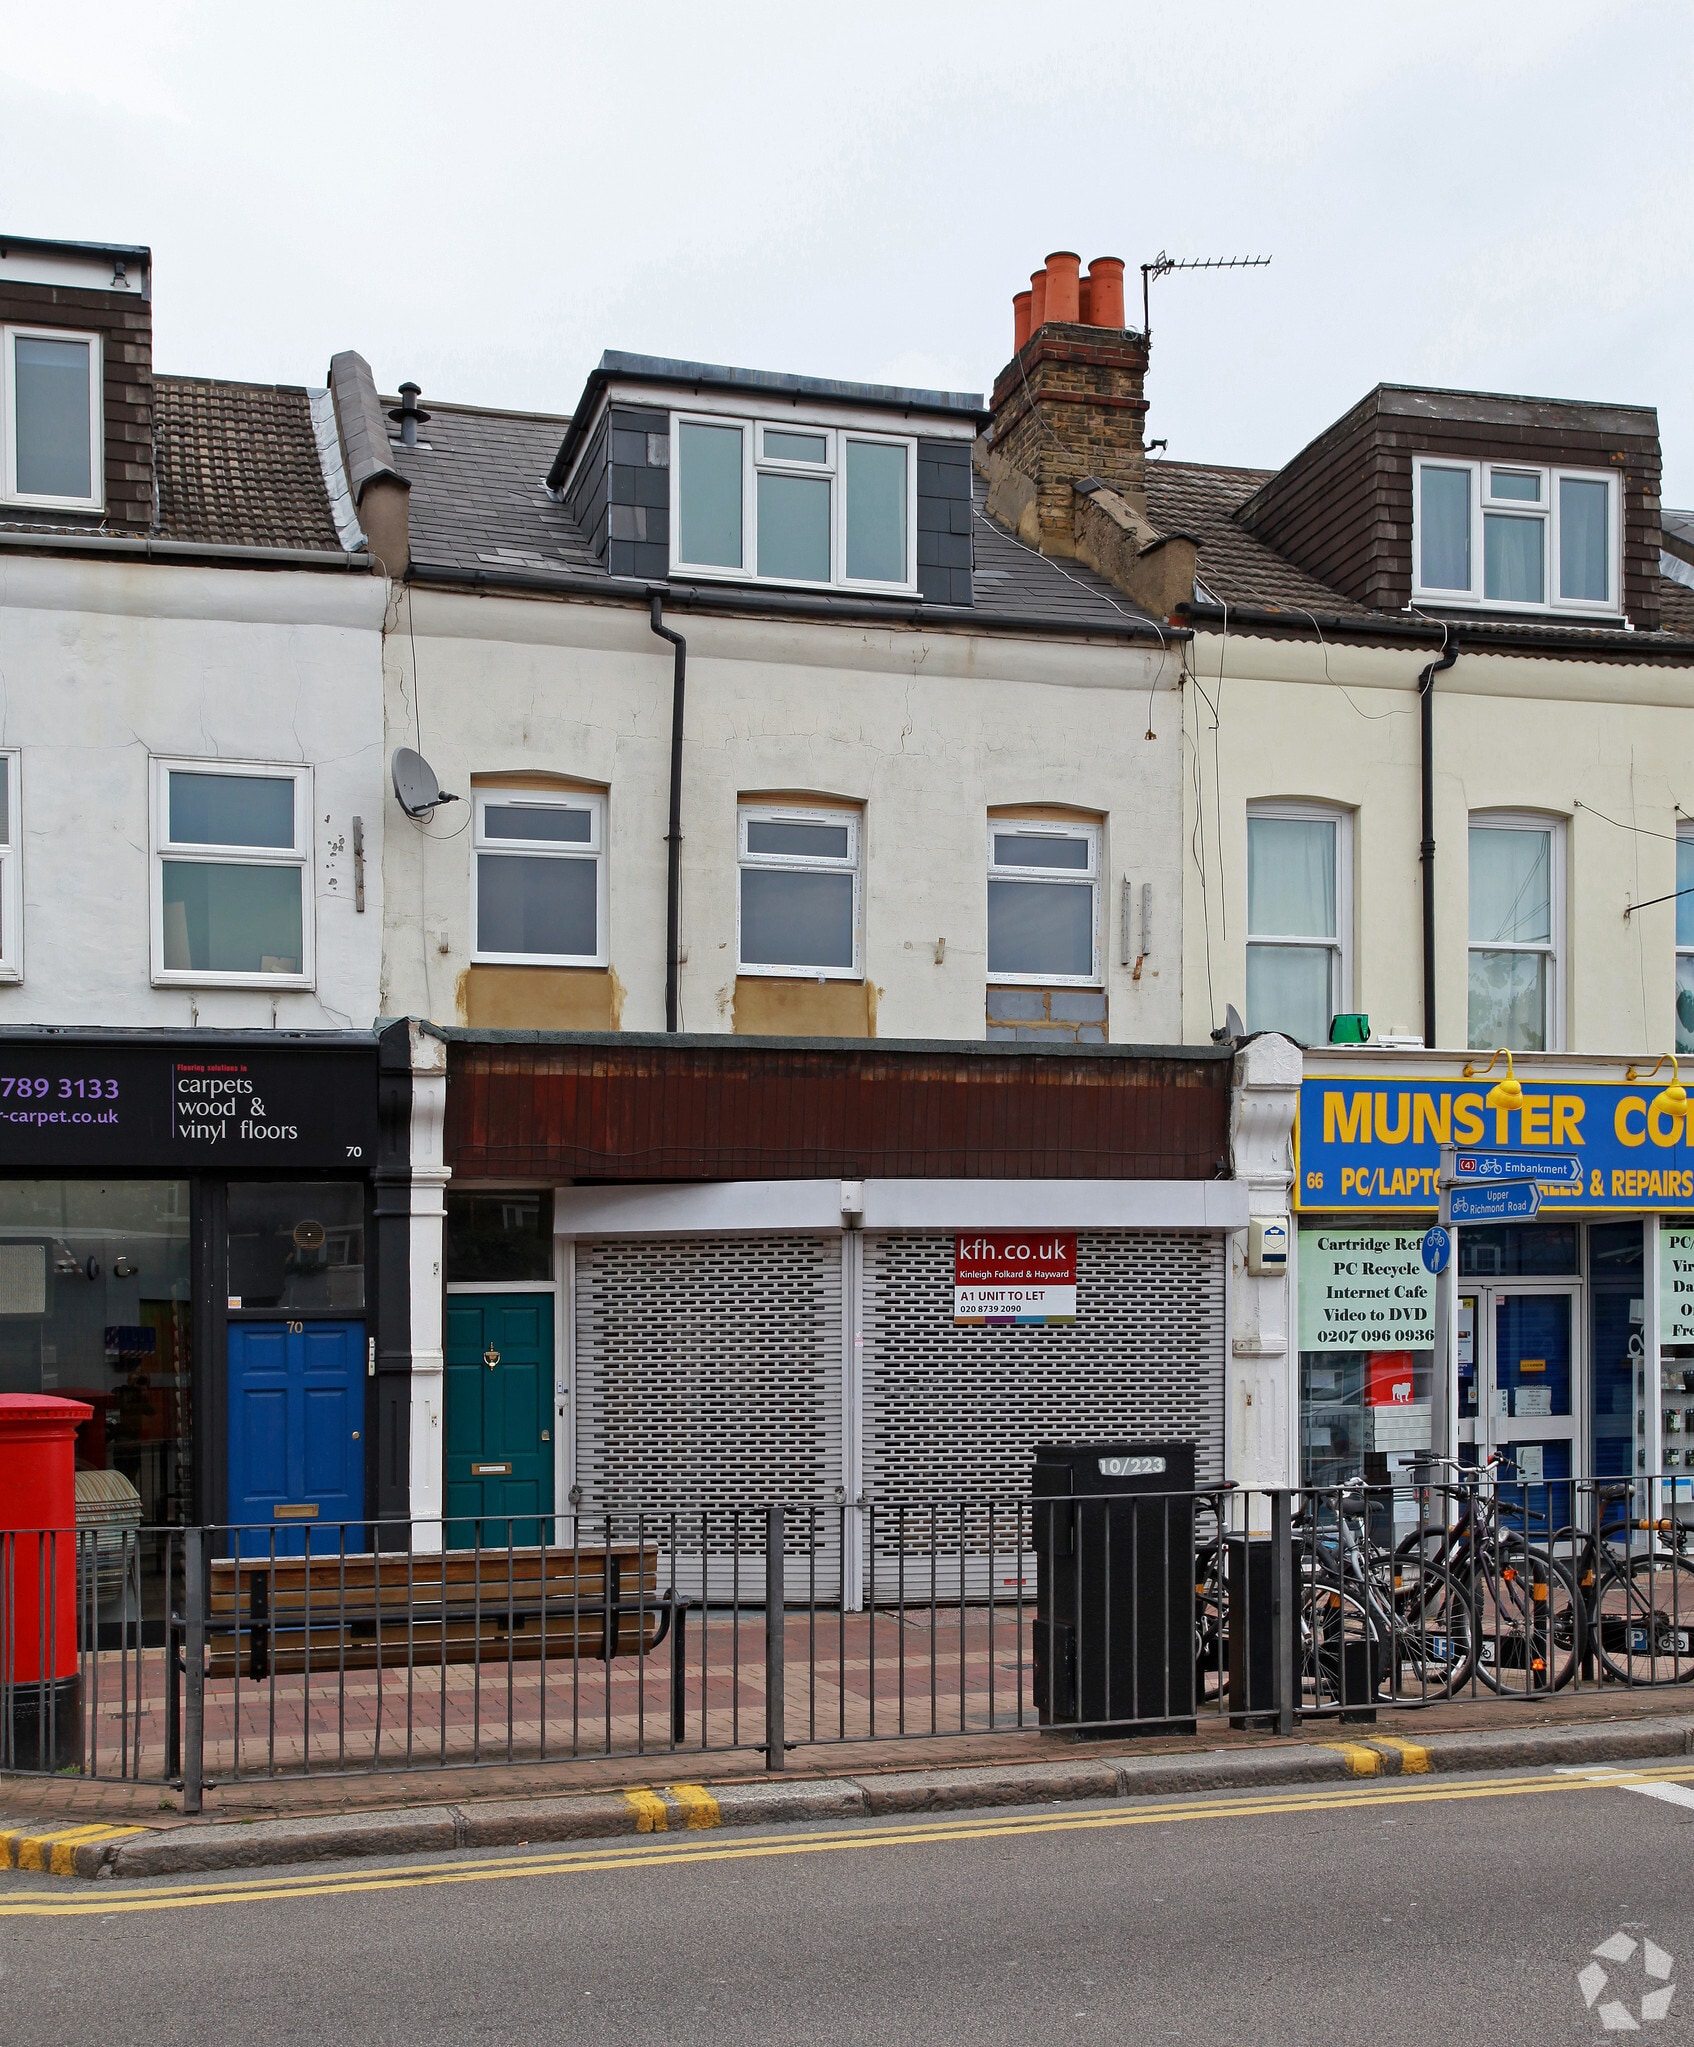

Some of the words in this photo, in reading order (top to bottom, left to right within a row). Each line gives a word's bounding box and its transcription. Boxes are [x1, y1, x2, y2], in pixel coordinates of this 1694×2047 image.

[177, 1064, 205, 1072] Flooring
[207, 1064, 238, 1072] solutions
[0, 1077, 50, 1098] 789
[57, 1078, 119, 1099] 3133
[178, 1078, 253, 1099] carpets
[177, 1097, 236, 1116] wood
[250, 1096, 267, 1116] &
[1323, 1091, 1586, 1145] MUNSTER
[1614, 1095, 1694, 1148] CO
[179, 1120, 226, 1145] vinyl
[240, 1120, 298, 1140] floors
[345, 1146, 362, 1158] 70
[1505, 1162, 1567, 1175] Embankment
[1306, 1171, 1324, 1189] 66
[1589, 1169, 1605, 1197] &
[1611, 1169, 1694, 1197] REPAIRS
[1487, 1190, 1509, 1202] Upper
[1469, 1202, 1505, 1215] Richmond
[1507, 1200, 1527, 1212] Road
[960, 1239, 1067, 1260] kfh.co.uk
[1317, 1237, 1391, 1254] Cartridge
[959, 1270, 992, 1280] Kinleigh
[994, 1270, 1024, 1279] Folkard
[1026, 1270, 1032, 1278] &
[1034, 1270, 1069, 1280] Hayward
[1333, 1262, 1358, 1275] PC
[1362, 1262, 1420, 1279] Recycle
[960, 1291, 975, 1301] A1
[978, 1291, 1006, 1301] UNIT
[1008, 1291, 1023, 1301] TO
[1026, 1291, 1045, 1301] LET
[1326, 1285, 1391, 1299] Internet
[1394, 1285, 1428, 1299] Cafe
[960, 1305, 976, 1313] 020
[977, 1305, 999, 1313] 8739
[1000, 1305, 1022, 1313] 2090
[1323, 1308, 1367, 1321] Video
[1370, 1309, 1385, 1321] to
[1389, 1307, 1428, 1321] DVD
[286, 1320, 304, 1334] 70
[1317, 1330, 1359, 1344] 0207
[1361, 1329, 1391, 1342] 096
[1394, 1329, 1435, 1342] 0936
[1100, 1457, 1164, 1476] 10/223
